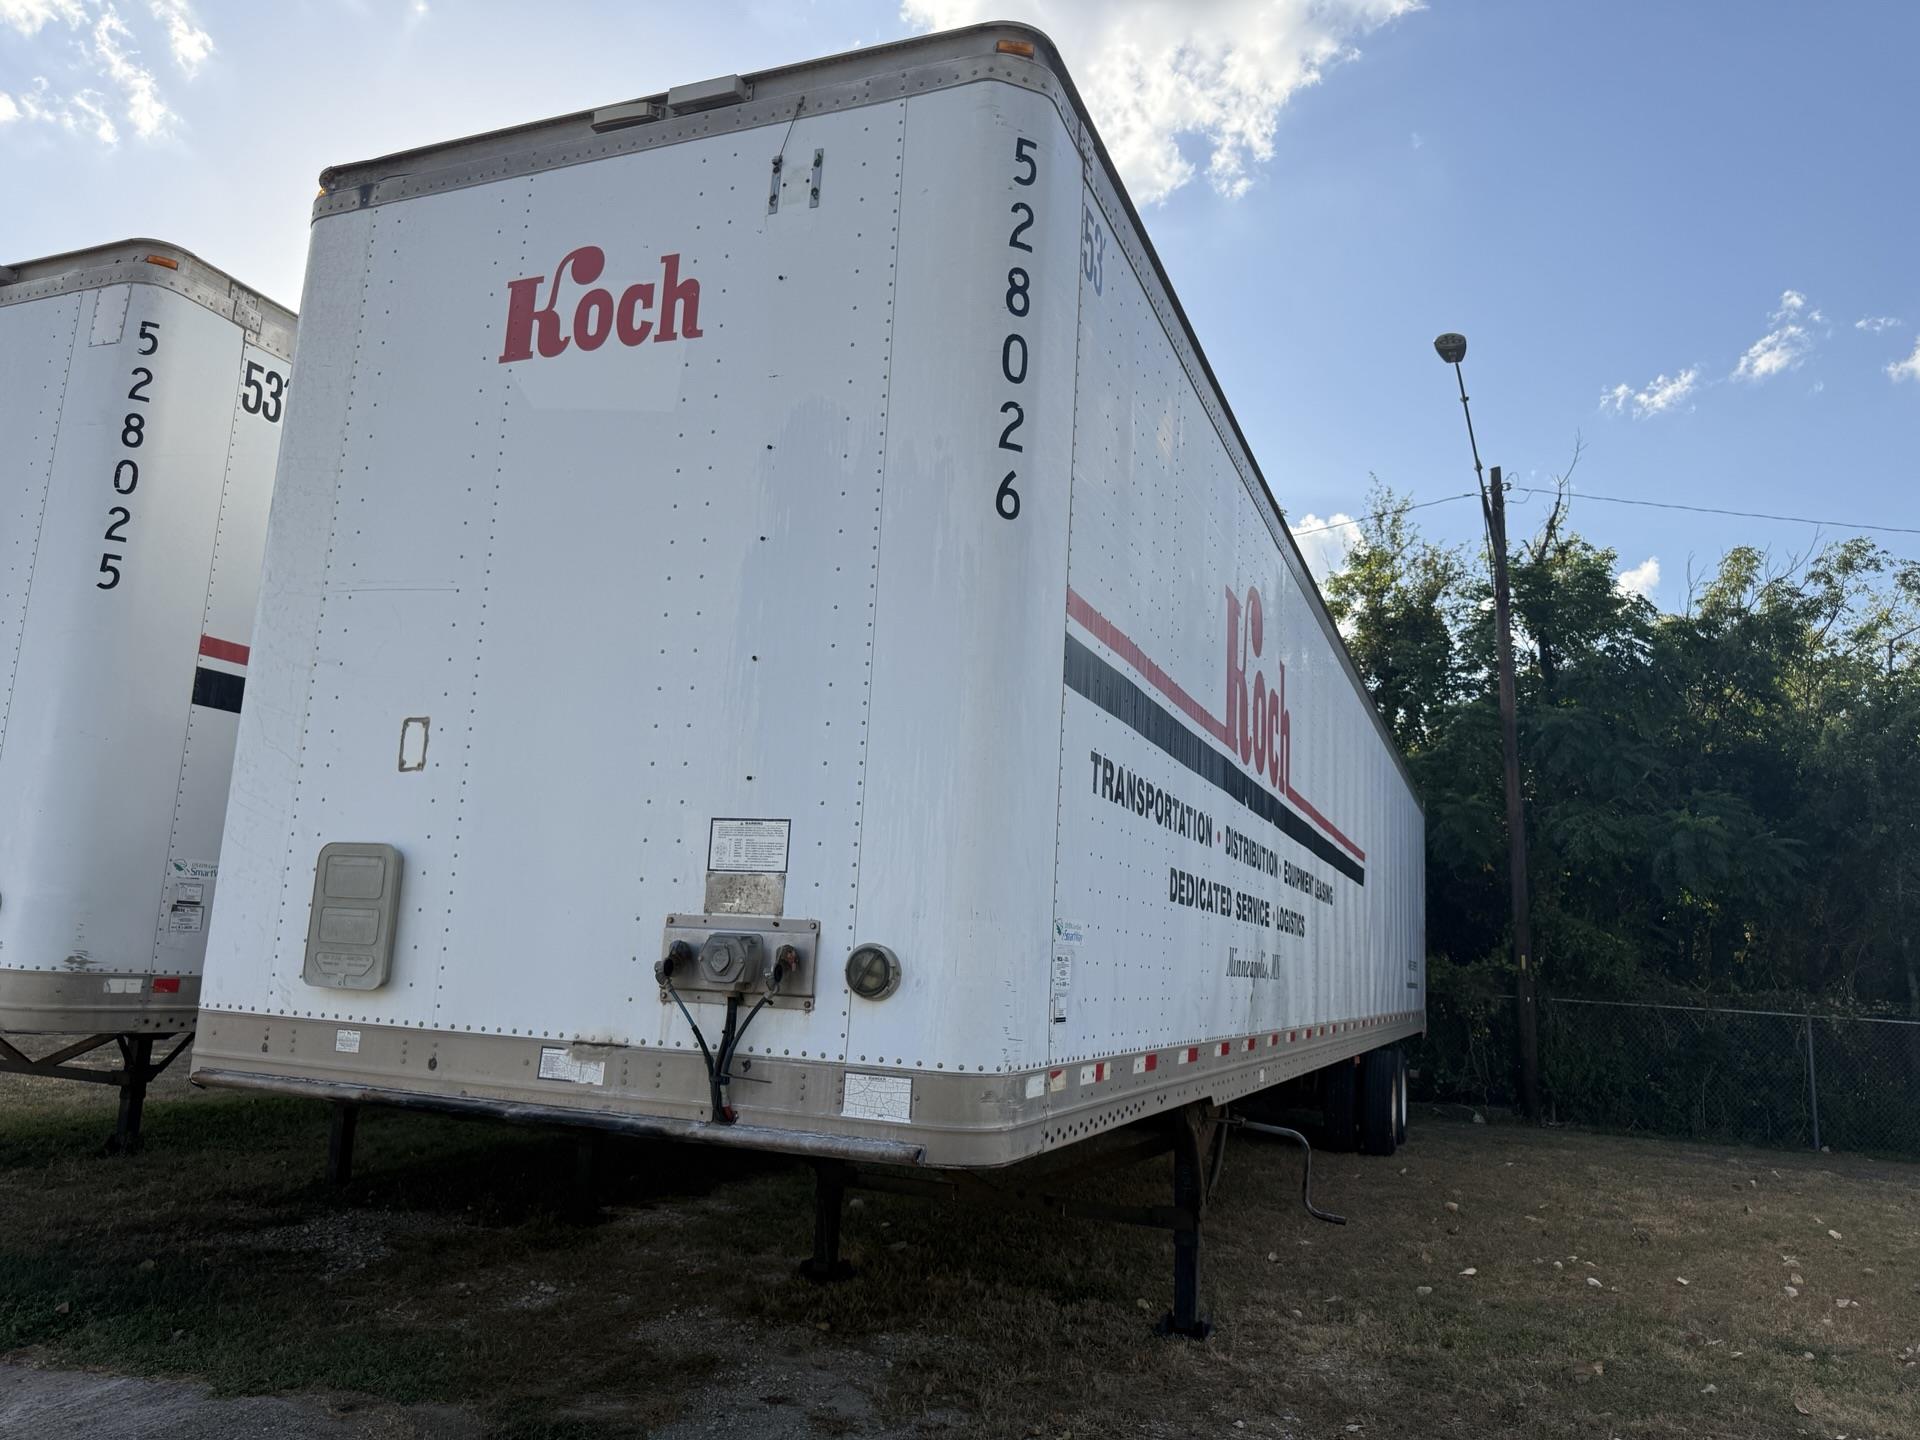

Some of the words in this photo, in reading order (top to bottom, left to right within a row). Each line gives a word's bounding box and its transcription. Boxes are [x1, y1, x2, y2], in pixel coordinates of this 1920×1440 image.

[498, 245, 704, 364] Koch
[995, 137, 1038, 521] 528026
[96, 320, 161, 590] 528025
[1225, 584, 1290, 797] Koch
[1090, 750, 1213, 848] TRANSPORTATION
[1226, 825, 1279, 879] DISTRIBUTION
[1284, 860, 1314, 897] EQUIPMENT
[1314, 877, 1334, 906] LEASING
[1169, 867, 1232, 918] DEDICATED
[1236, 891, 1270, 928] SERVICE
[1277, 905, 1306, 938] LOGISTICS
